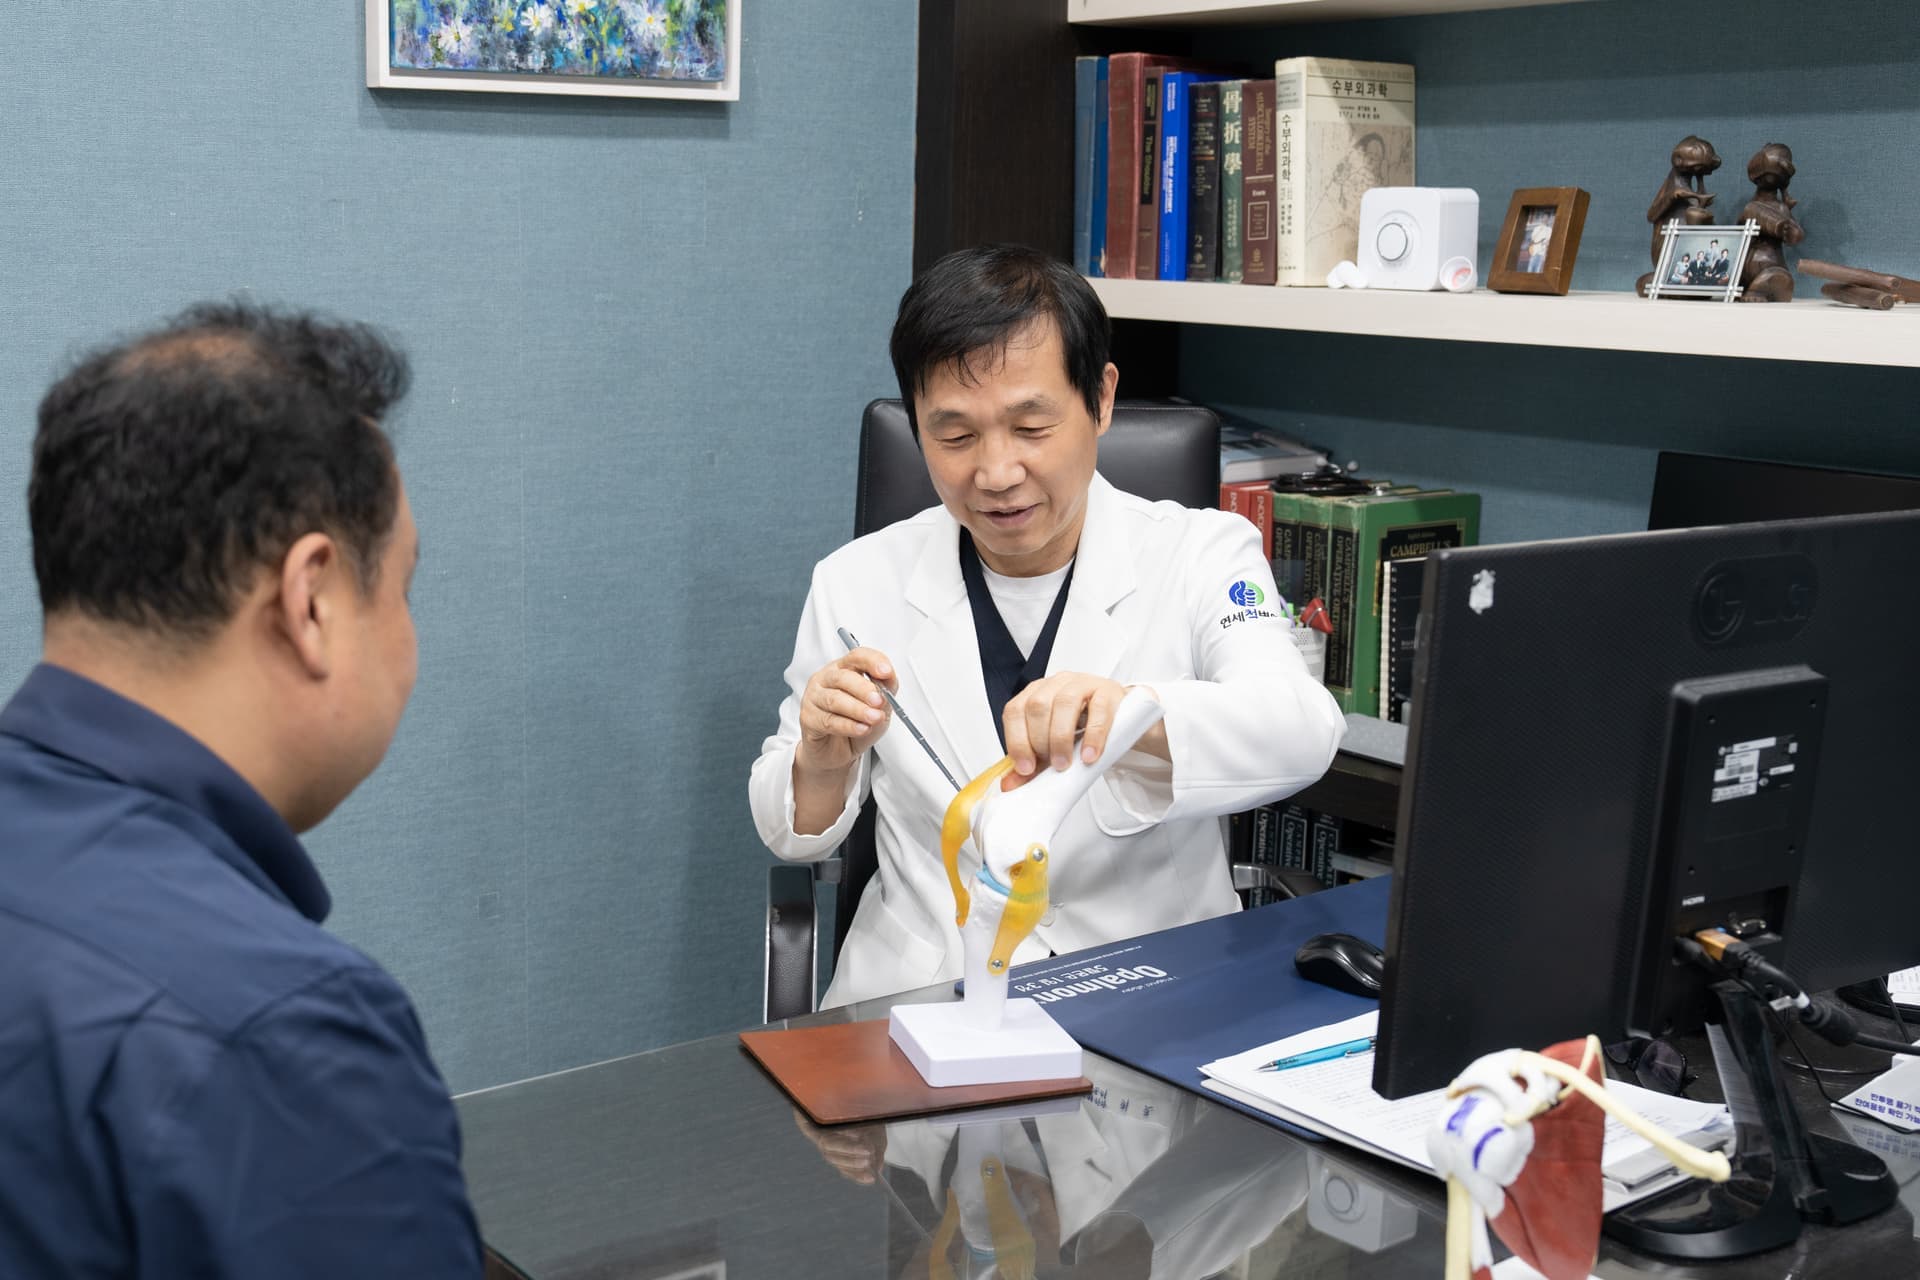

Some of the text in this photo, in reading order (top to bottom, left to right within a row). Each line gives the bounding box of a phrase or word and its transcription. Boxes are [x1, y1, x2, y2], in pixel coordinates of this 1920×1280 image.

[1331, 80, 1389, 98] 수부외과학
[1223, 90, 1242, 175] 骨折學
[1280, 113, 1293, 183] 수부외과학
[1194, 235, 1203, 248] 2
[1332, 535, 1344, 596] OPERATIVE
[1326, 833, 1336, 886] CAMPBEL
[1031, 964, 1168, 1004] Opalmon
